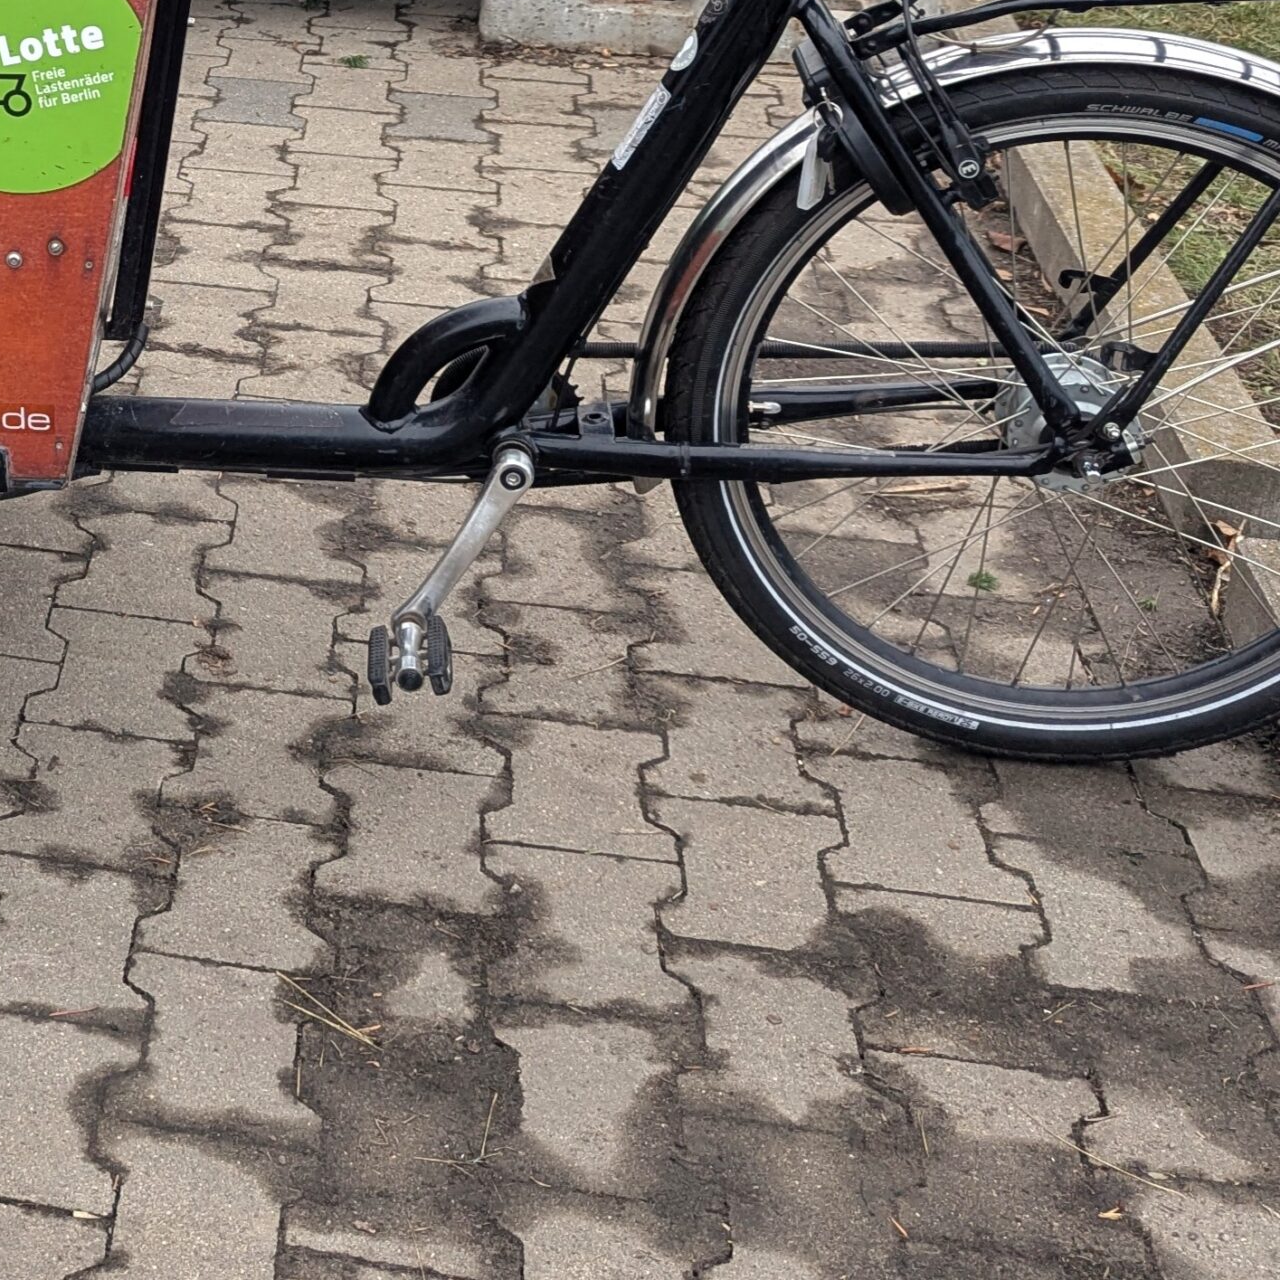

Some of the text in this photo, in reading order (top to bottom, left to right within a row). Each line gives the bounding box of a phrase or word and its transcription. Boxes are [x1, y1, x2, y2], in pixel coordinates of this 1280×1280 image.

[31, 67, 66, 82] Freie
[34, 71, 115, 96] Lastenräder
[38, 88, 101, 109] für Berlin
[1084, 103, 1194, 121] SCHWALBE
[788, 625, 838, 666] 50-559
